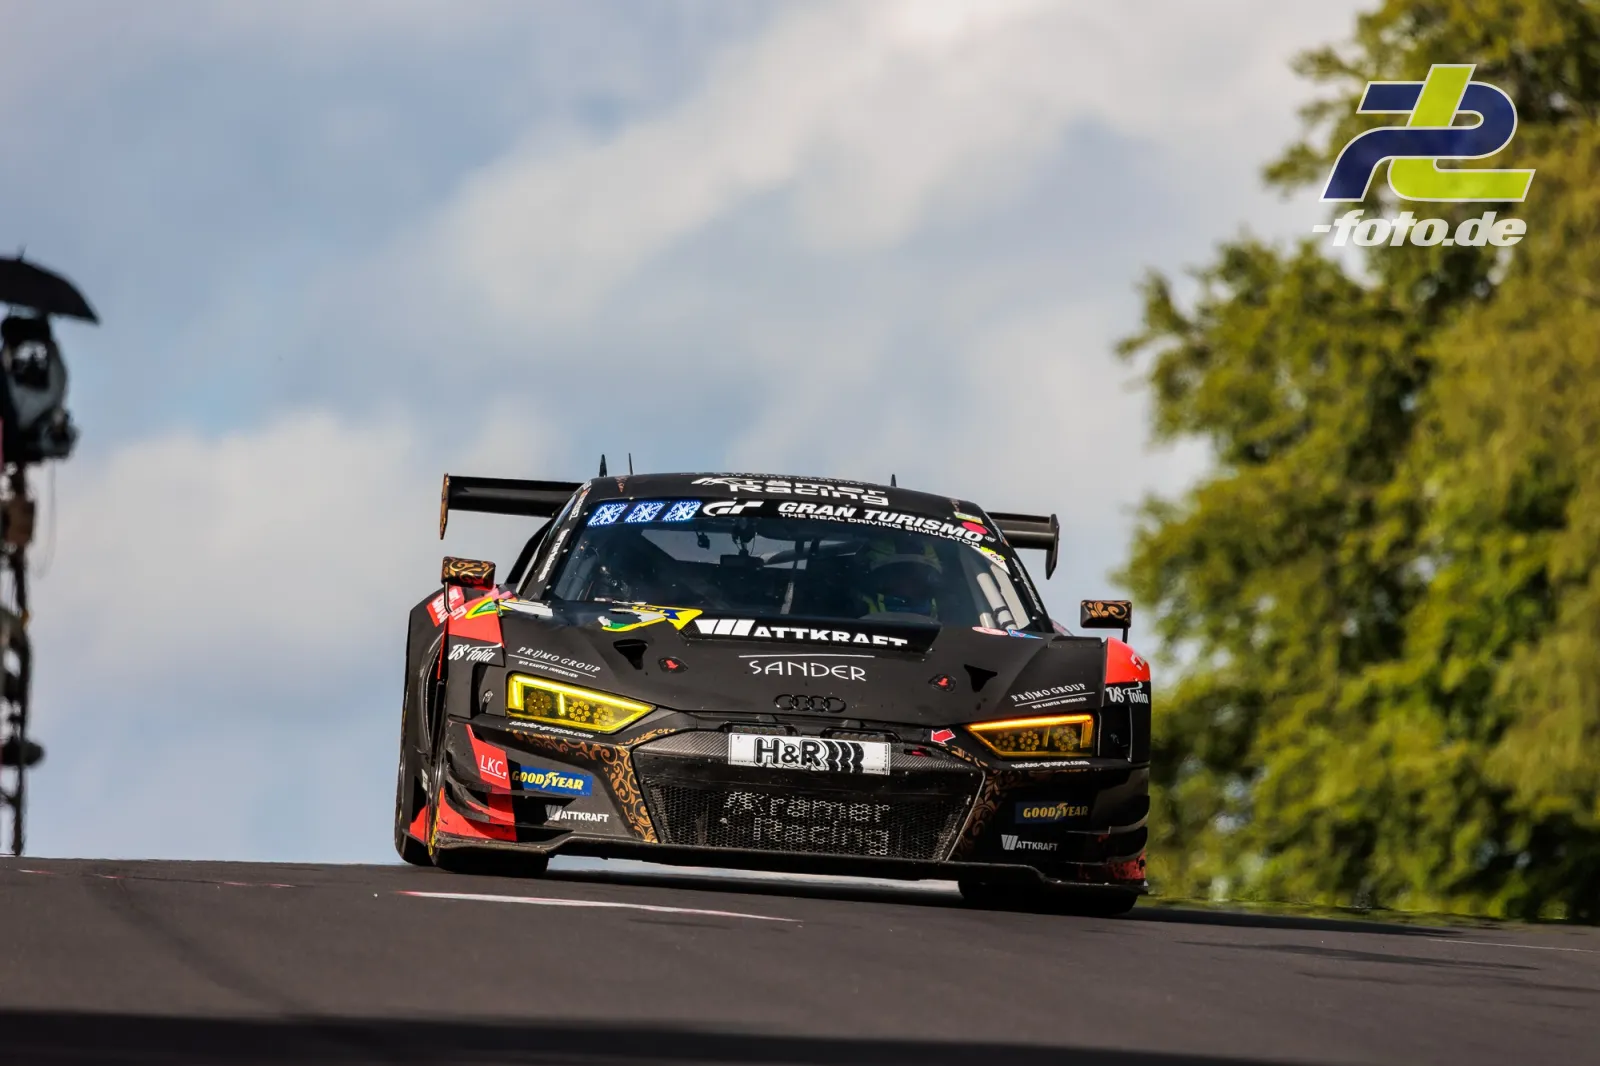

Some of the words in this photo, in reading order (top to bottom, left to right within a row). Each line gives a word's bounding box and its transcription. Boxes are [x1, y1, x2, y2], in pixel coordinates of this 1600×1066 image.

[730, 483, 889, 506] Racing
[778, 502, 858, 518] GRAN
[865, 508, 984, 542] TURISMO
[812, 514, 845, 522] REAL
[848, 518, 902, 530] DRIVING
[905, 524, 981, 548] SIMULATOR
[466, 643, 503, 662] Folia
[560, 655, 601, 673] GROUP
[749, 660, 867, 681] SANDER
[1050, 683, 1086, 695] GROUP
[754, 737, 826, 769] H&R
[512, 771, 584, 790] GOODYEAR
[1023, 802, 1089, 820] GOODYEAR
[753, 817, 889, 856] Racing
